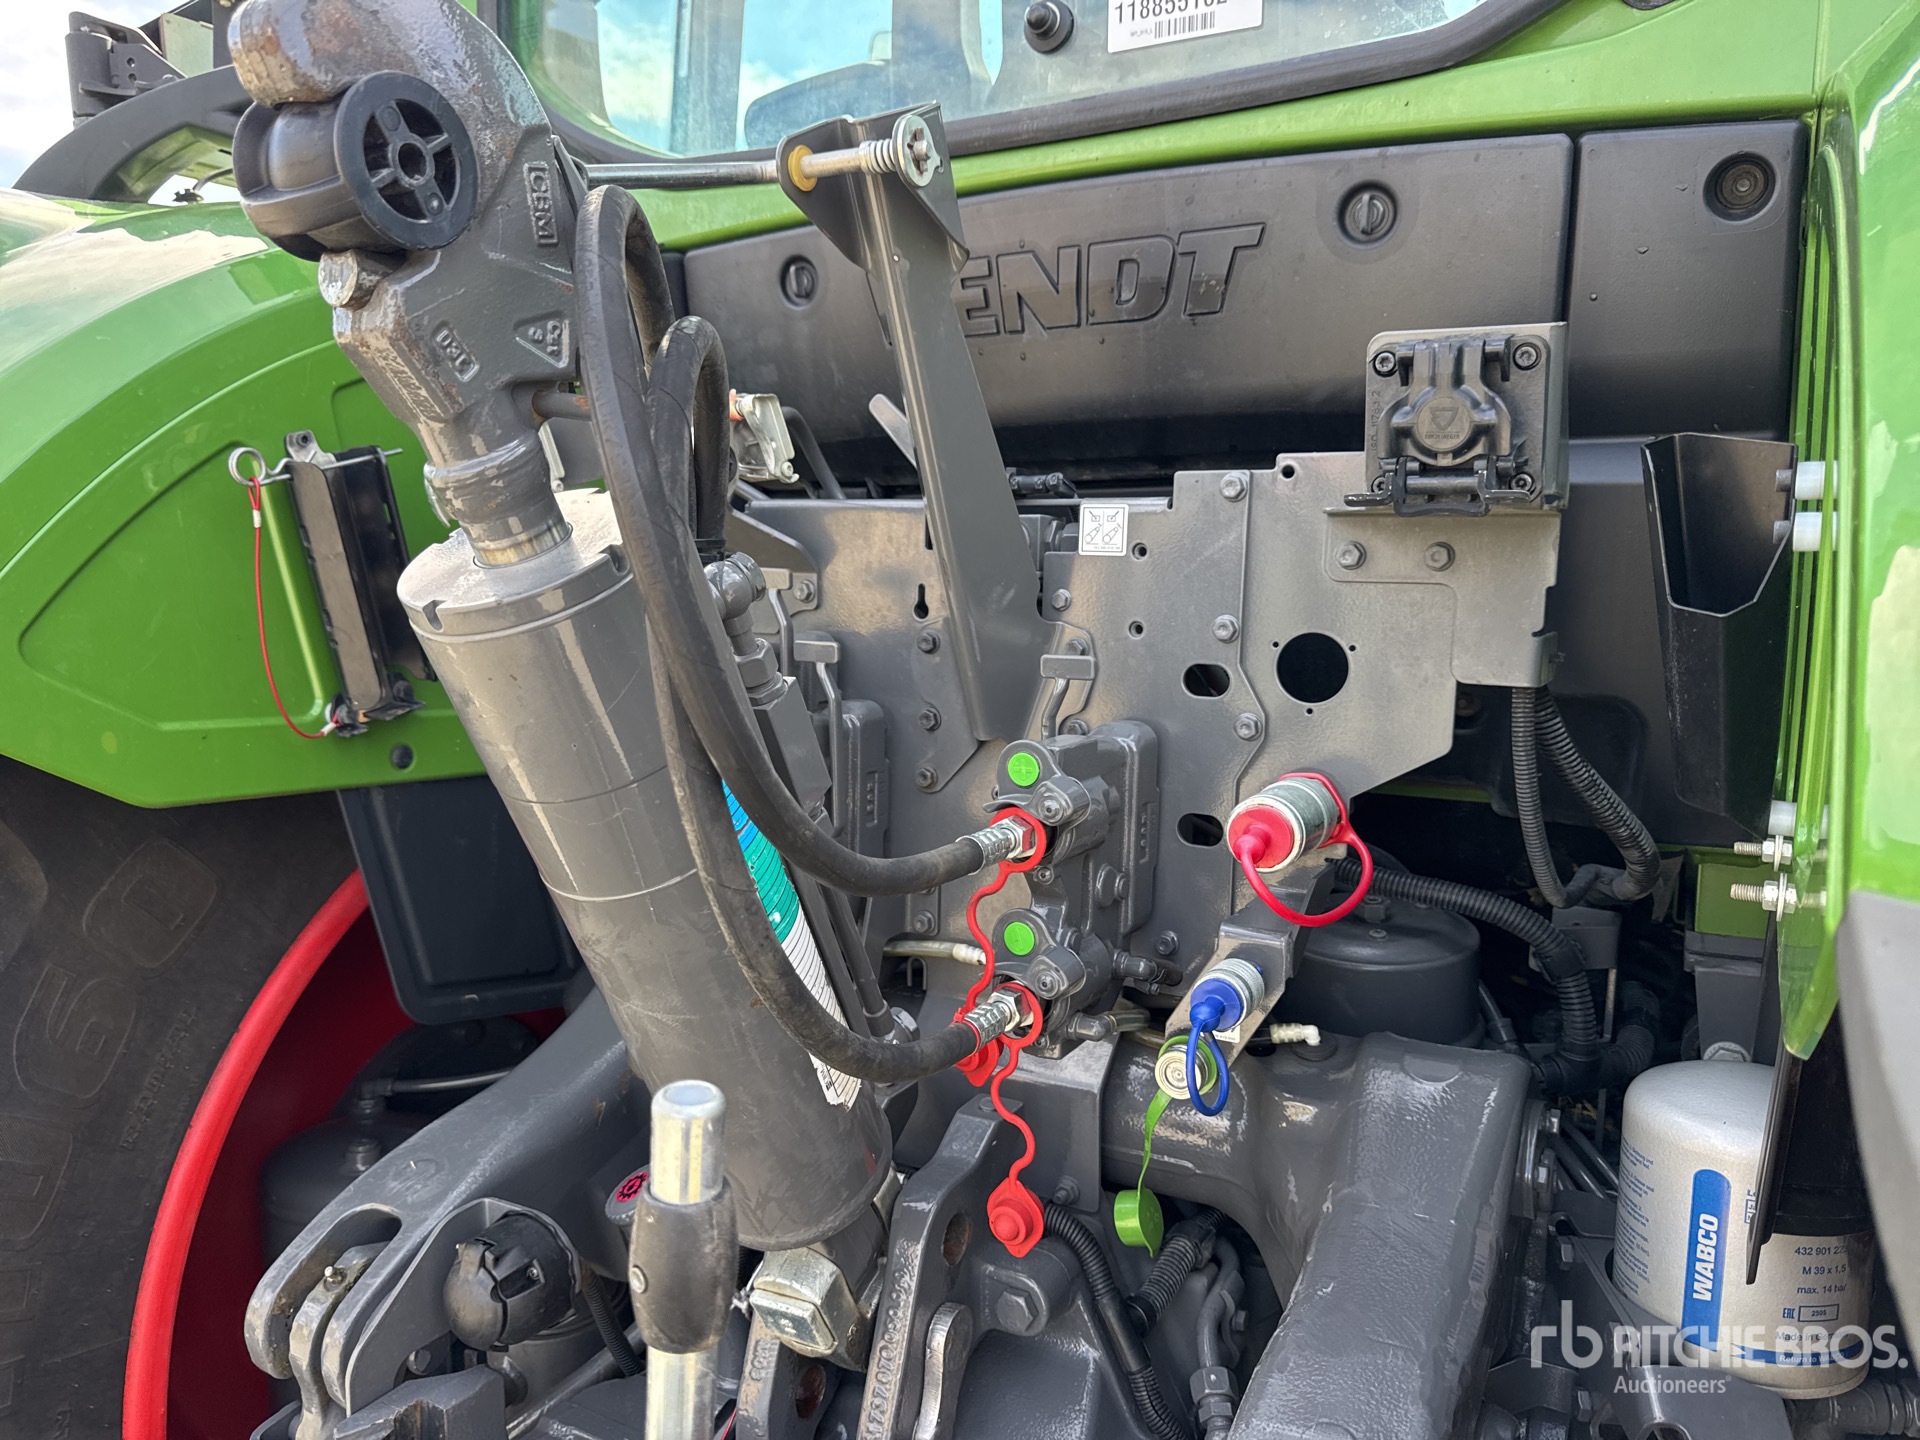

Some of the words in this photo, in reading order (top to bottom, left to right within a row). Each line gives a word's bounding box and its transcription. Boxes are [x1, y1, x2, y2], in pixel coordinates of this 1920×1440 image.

[1115, 0, 1227, 24] 118855
[866, 222, 1266, 346] ENDT
[1692, 1213, 1718, 1301] WABCO
[1794, 1246, 1813, 1256] 432
[1815, 1246, 1831, 1255] 901
[1802, 1266, 1812, 1275] M
[1814, 1266, 1826, 1275] 39
[1834, 1264, 1847, 1275] 1,5
[1797, 1286, 1819, 1294] max.
[1823, 1285, 1832, 1294] 14
